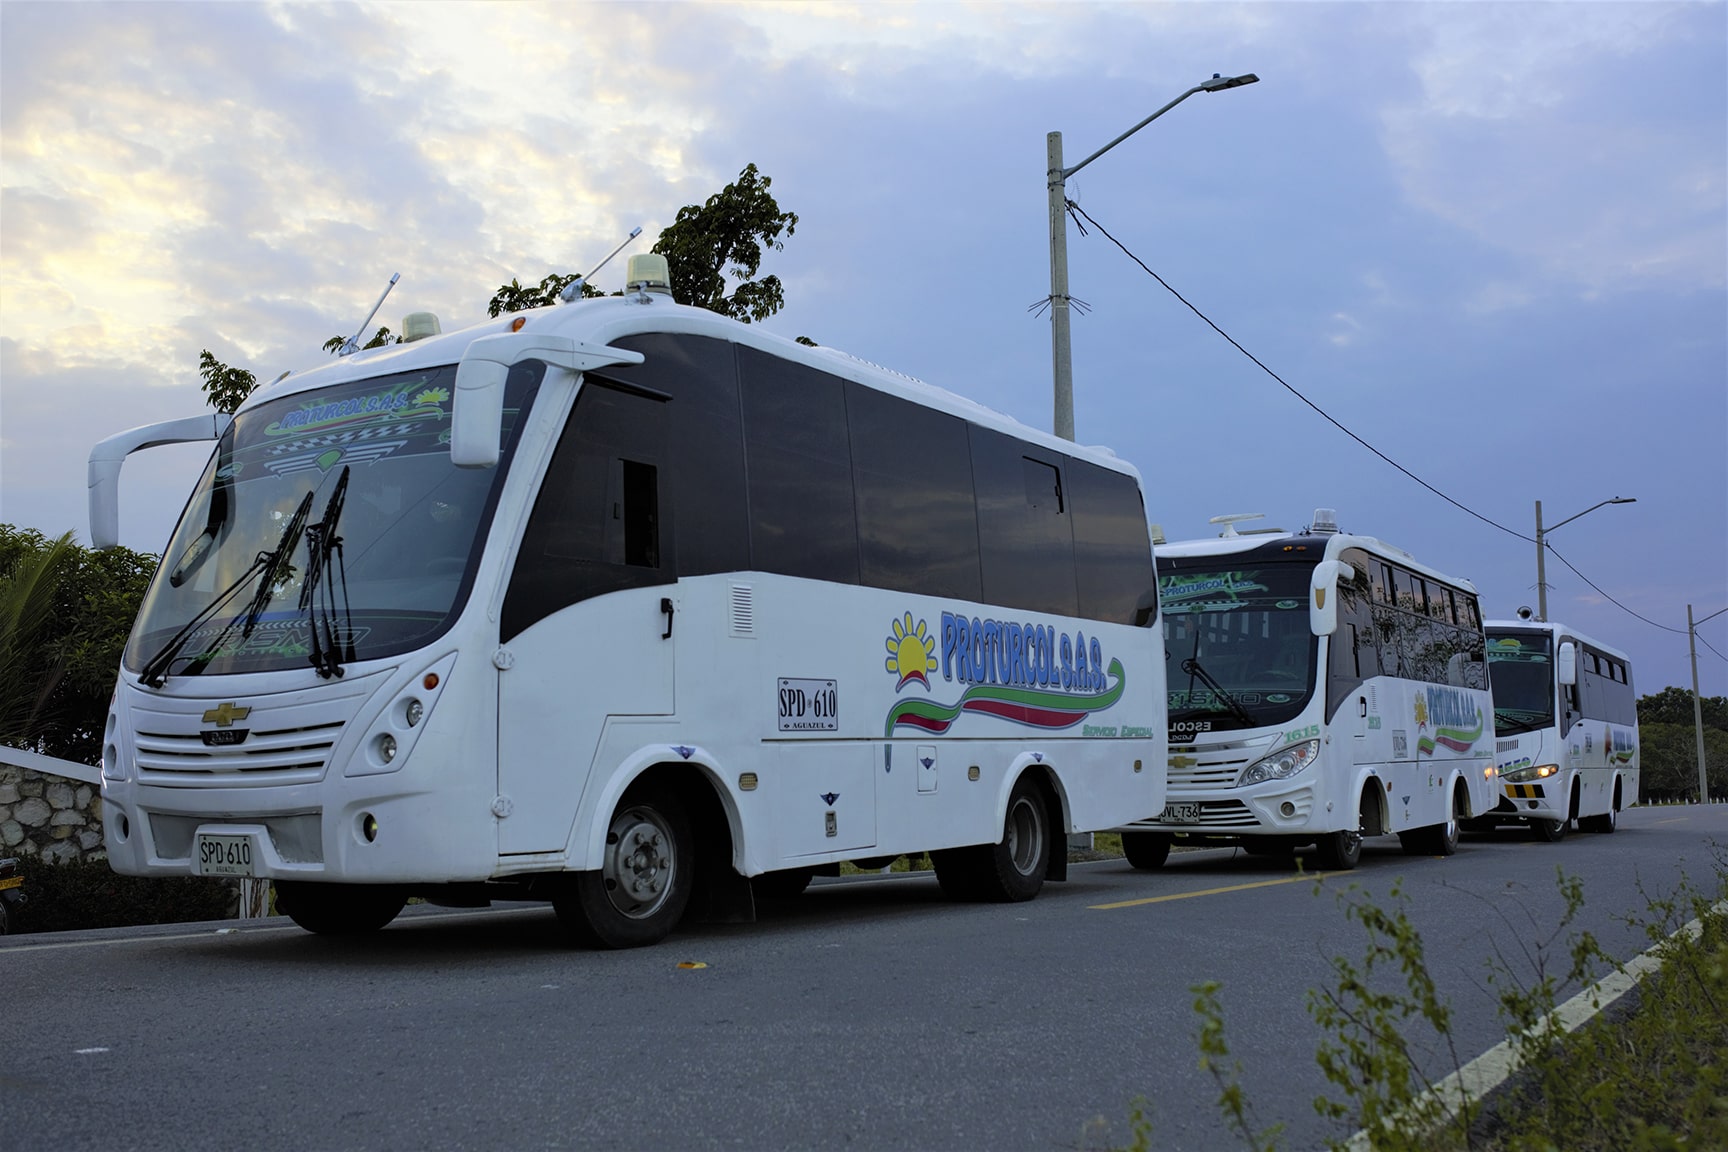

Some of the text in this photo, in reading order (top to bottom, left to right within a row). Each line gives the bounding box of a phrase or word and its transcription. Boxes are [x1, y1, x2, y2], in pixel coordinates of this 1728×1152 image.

[279, 396, 366, 429] PROTURCOL
[1164, 579, 1226, 596] PROTURCOL
[940, 610, 1107, 692] PROTURCOL S.A.S.
[779, 688, 837, 719] SPD 610
[792, 721, 827, 730] AGUAZUL
[1284, 725, 1320, 744] 1615
[1179, 806, 1199, 818] 736
[200, 841, 251, 865] SPD 610
